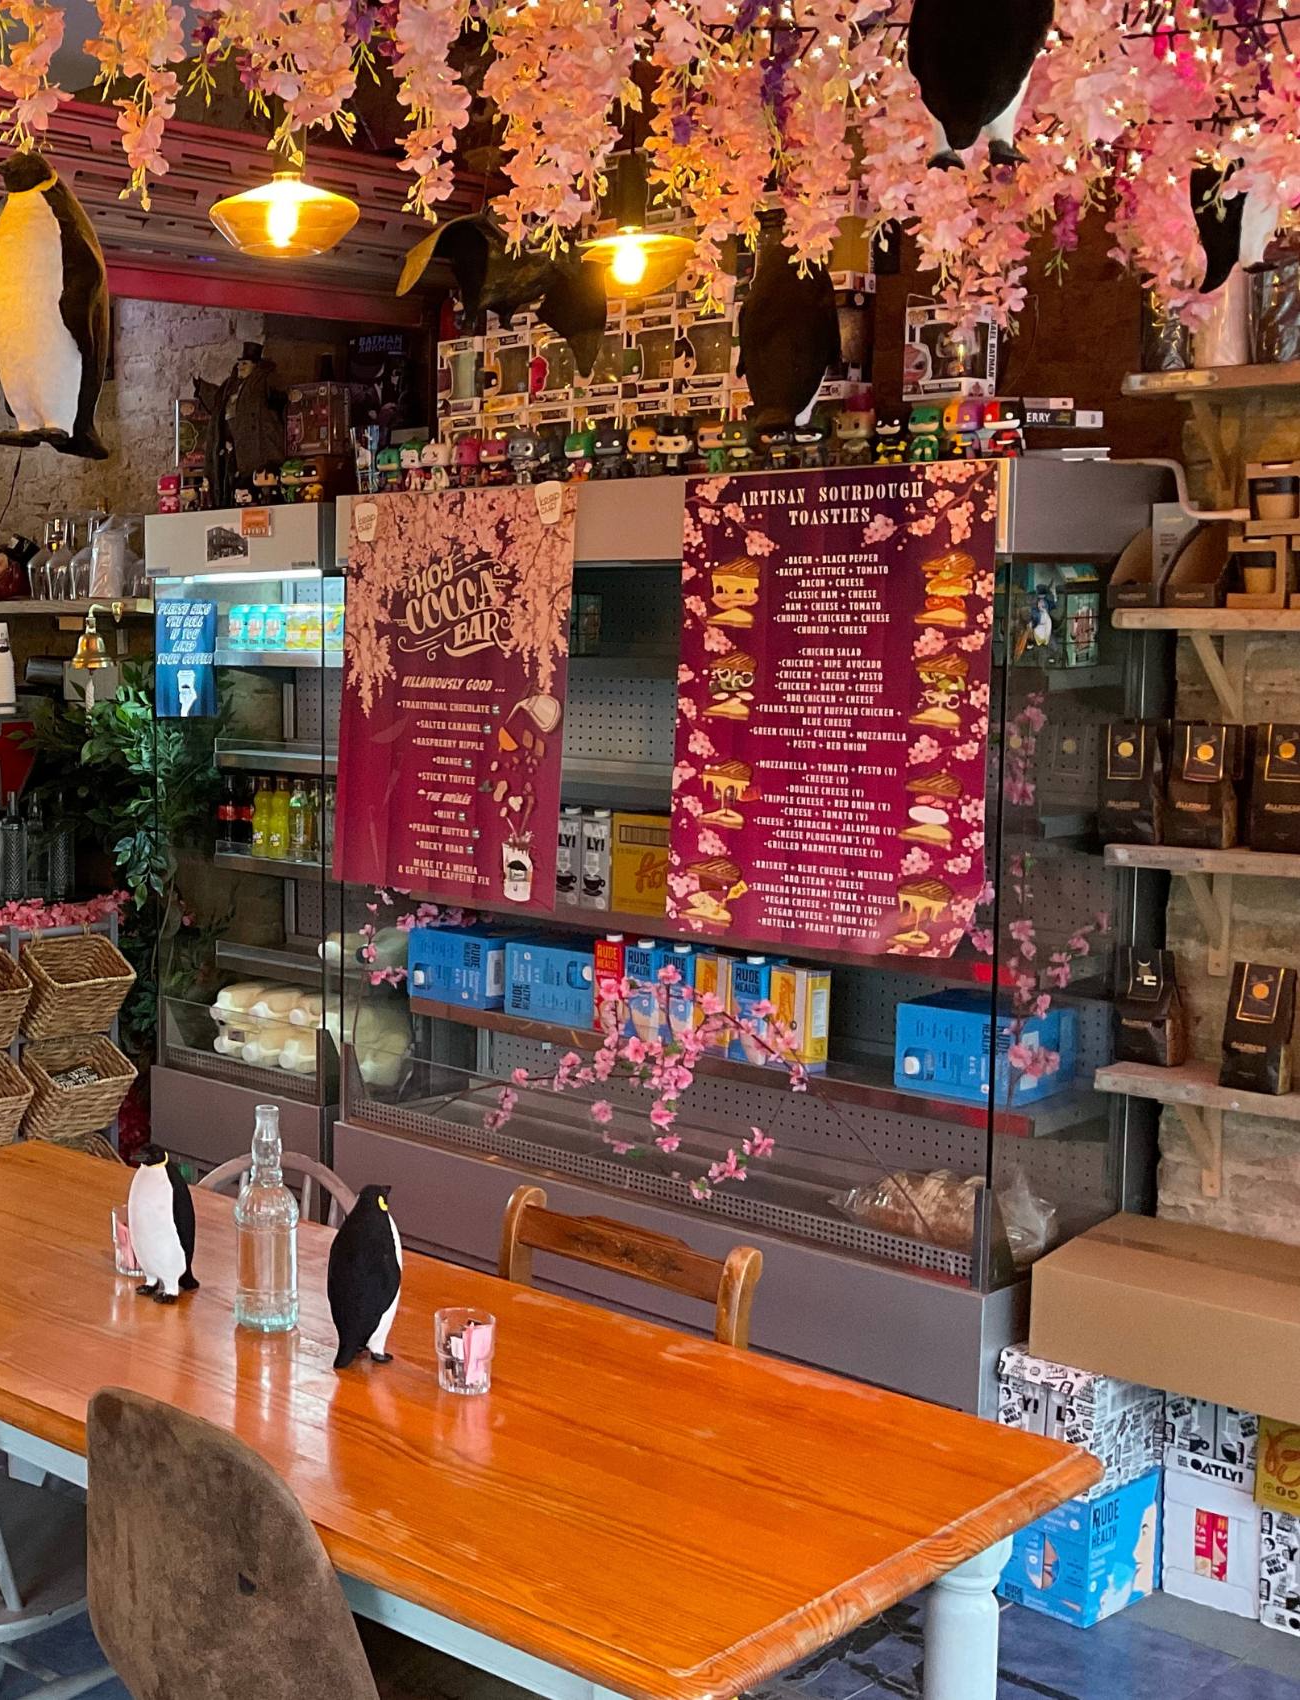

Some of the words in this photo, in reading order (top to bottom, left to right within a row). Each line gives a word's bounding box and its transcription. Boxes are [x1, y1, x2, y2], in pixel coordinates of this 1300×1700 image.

[740, 487, 806, 508] ARTISAN
[818, 481, 924, 502] SOURDOUGH
[788, 506, 871, 526] TOASTIES
[788, 555, 811, 564] BACON
[822, 554, 846, 563] BLACK
[849, 553, 877, 562] PEPPER
[408, 554, 455, 598] HOT
[779, 567, 802, 576] BACON
[812, 566, 845, 575] LETTUCE
[856, 565, 888, 574] TOMATO
[406, 569, 497, 634] COCOA
[788, 590, 818, 599] CLASSIC
[821, 590, 837, 598] HAM
[848, 589, 876, 598] CHEESE
[776, 614, 807, 622] CHORIZO
[818, 613, 850, 622] CHICKEN
[861, 613, 889, 622] CHEESE
[453, 611, 503, 648] BAR
[801, 647, 833, 656] CHICKEN
[837, 647, 861, 656] SALAD
[781, 659, 813, 667] CHICKEN
[824, 659, 840, 667] RIPE
[846, 659, 881, 668] AVOCADO
[402, 675, 462, 690] VILLAINOUSLY
[466, 679, 492, 691] GOOD
[402, 700, 447, 710] TRADITIONAL
[450, 703, 489, 713] CHOCOLATE
[759, 704, 787, 712] FRANKS
[790, 705, 804, 713] RED
[807, 705, 821, 714] HOT
[824, 706, 857, 715] BUFFALO
[860, 707, 893, 716] CHICKEN
[420, 720, 445, 729] SALTED
[448, 722, 480, 731] CARAMEL
[802, 717, 820, 725] BLUE
[824, 717, 850, 727] CHEESE
[753, 726, 776, 735] GREEN
[779, 727, 803, 736] CHILLI
[813, 729, 846, 738] CHICKEN
[856, 730, 906, 741] MOZZARELLA
[416, 737, 456, 747] RASPBERRY
[459, 740, 483, 750] RIPPLE
[793, 739, 815, 748] PESTO
[826, 741, 840, 750] RED
[843, 742, 866, 751] ONION
[436, 756, 461, 765] ORANGE
[422, 771, 446, 781] STICKY
[449, 774, 474, 784] TOFFEE
[426, 792, 442, 802] THE
[763, 794, 793, 804] TRIPPLE
[796, 796, 823, 806] CHEESE
[834, 799, 848, 808] RED
[851, 800, 874, 810] ONION
[878, 802, 890, 811] (V)
[437, 810, 454, 819] MINT
[412, 822, 439, 833] PEANUT
[442, 826, 468, 837] BUTTER
[756, 816, 783, 826] CHEESE
[794, 819, 830, 830] SRIRACHA
[883, 826, 895, 835] (V)
[586, 837, 605, 852] LY!
[775, 829, 802, 839] CHEESE
[862, 836, 874, 845] (V)
[420, 840, 442, 850] ROCKY
[445, 843, 463, 853] ROAD
[767, 839, 799, 850] GRILLED
[802, 843, 836, 853] MARMITE
[839, 846, 866, 857] CHEESE
[870, 849, 882, 858] (V)
[413, 858, 433, 868] MAKE
[436, 861, 442, 869] IT
[453, 863, 477, 874] MOCHA
[755, 859, 786, 870] BRISKET
[798, 863, 816, 873] BLUE
[819, 865, 846, 876] CHEESE
[857, 869, 893, 881] MUSTARD
[405, 865, 418, 875] GET
[421, 867, 439, 877] YOUR
[441, 870, 474, 883] CAFFEINE
[478, 875, 489, 885] FIX
[752, 882, 789, 893] SRIRACHA
[792, 886, 830, 898] PASTRAMI
[833, 890, 856, 901] STEAK
[867, 894, 894, 905] CHEESE
[765, 894, 789, 905] VEGAN
[792, 897, 819, 908] CHEESE
[830, 901, 860, 913] TOMATO
[864, 905, 881, 915] (VG)
[471, 943, 481, 968] RUDE
[596, 944, 618, 960] RUDE
[628, 950, 650, 964] RUDE
[596, 958, 618, 970] HEALTH
[664, 954, 686, 969] RUDE
[627, 964, 650, 977] HEALTH
[736, 968, 760, 983] RUDE
[512, 982, 523, 1009] RUDE
[735, 982, 760, 995] HEALTH
[1190, 1458, 1244, 1484] OATLY!
[1092, 1498, 1120, 1530] RUDE
[1091, 1524, 1118, 1550] HEALTH
